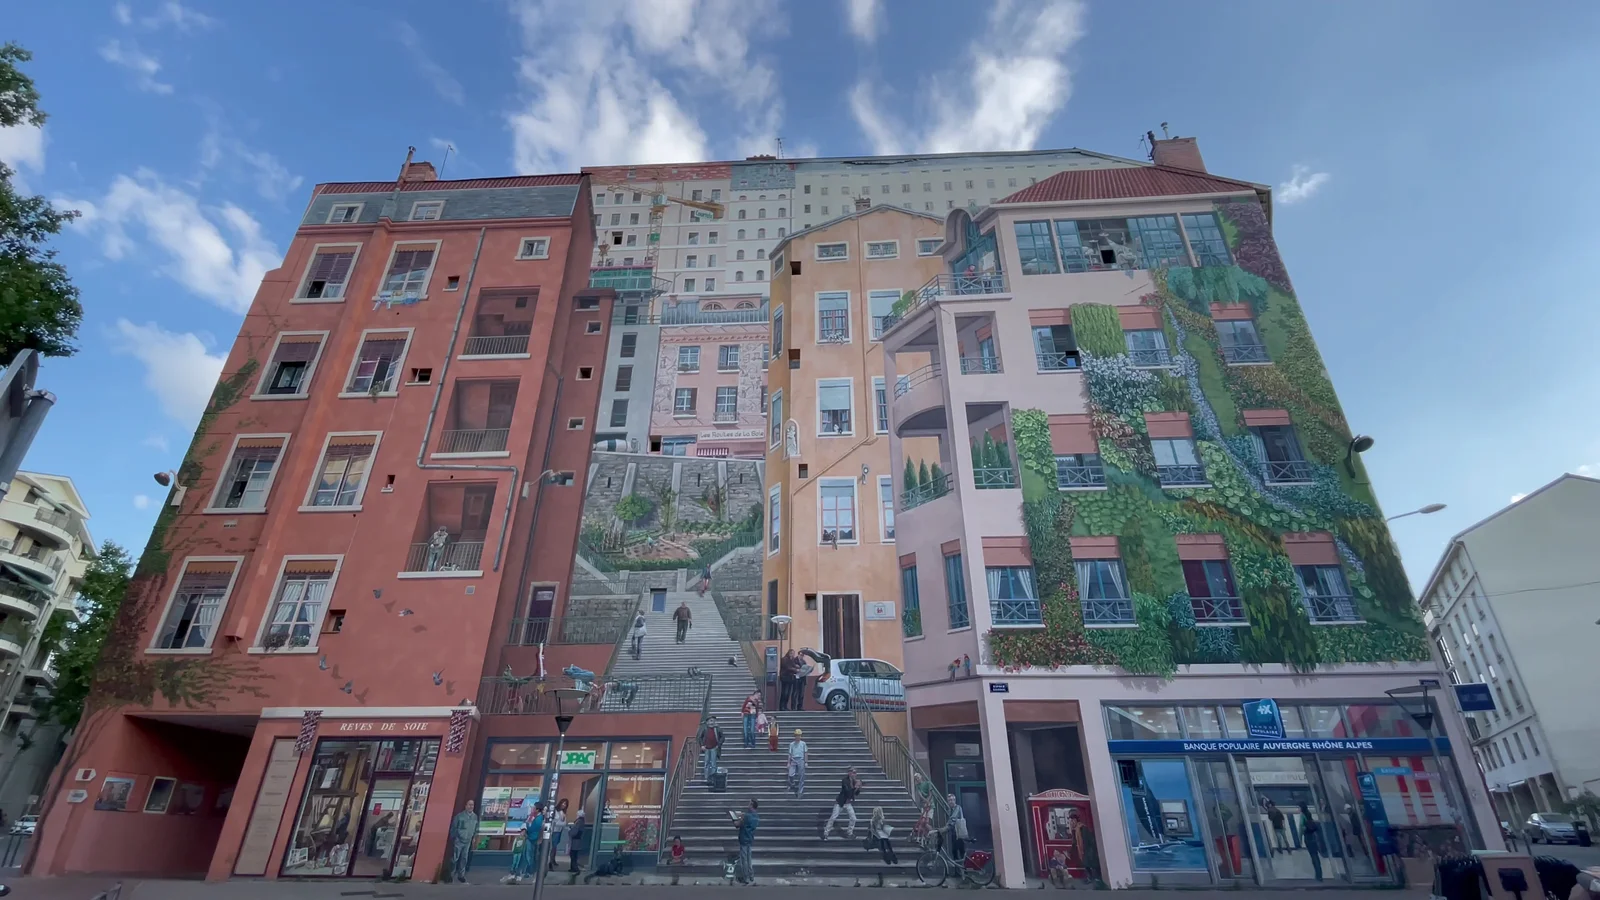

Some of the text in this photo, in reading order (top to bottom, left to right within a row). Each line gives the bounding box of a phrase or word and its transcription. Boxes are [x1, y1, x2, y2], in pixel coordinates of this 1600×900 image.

[340, 722, 429, 731] REVES DE SOIE
[1183, 740, 1373, 751] BANQUE POPULAIRE AUVERGNE RHÔNE ALPES
